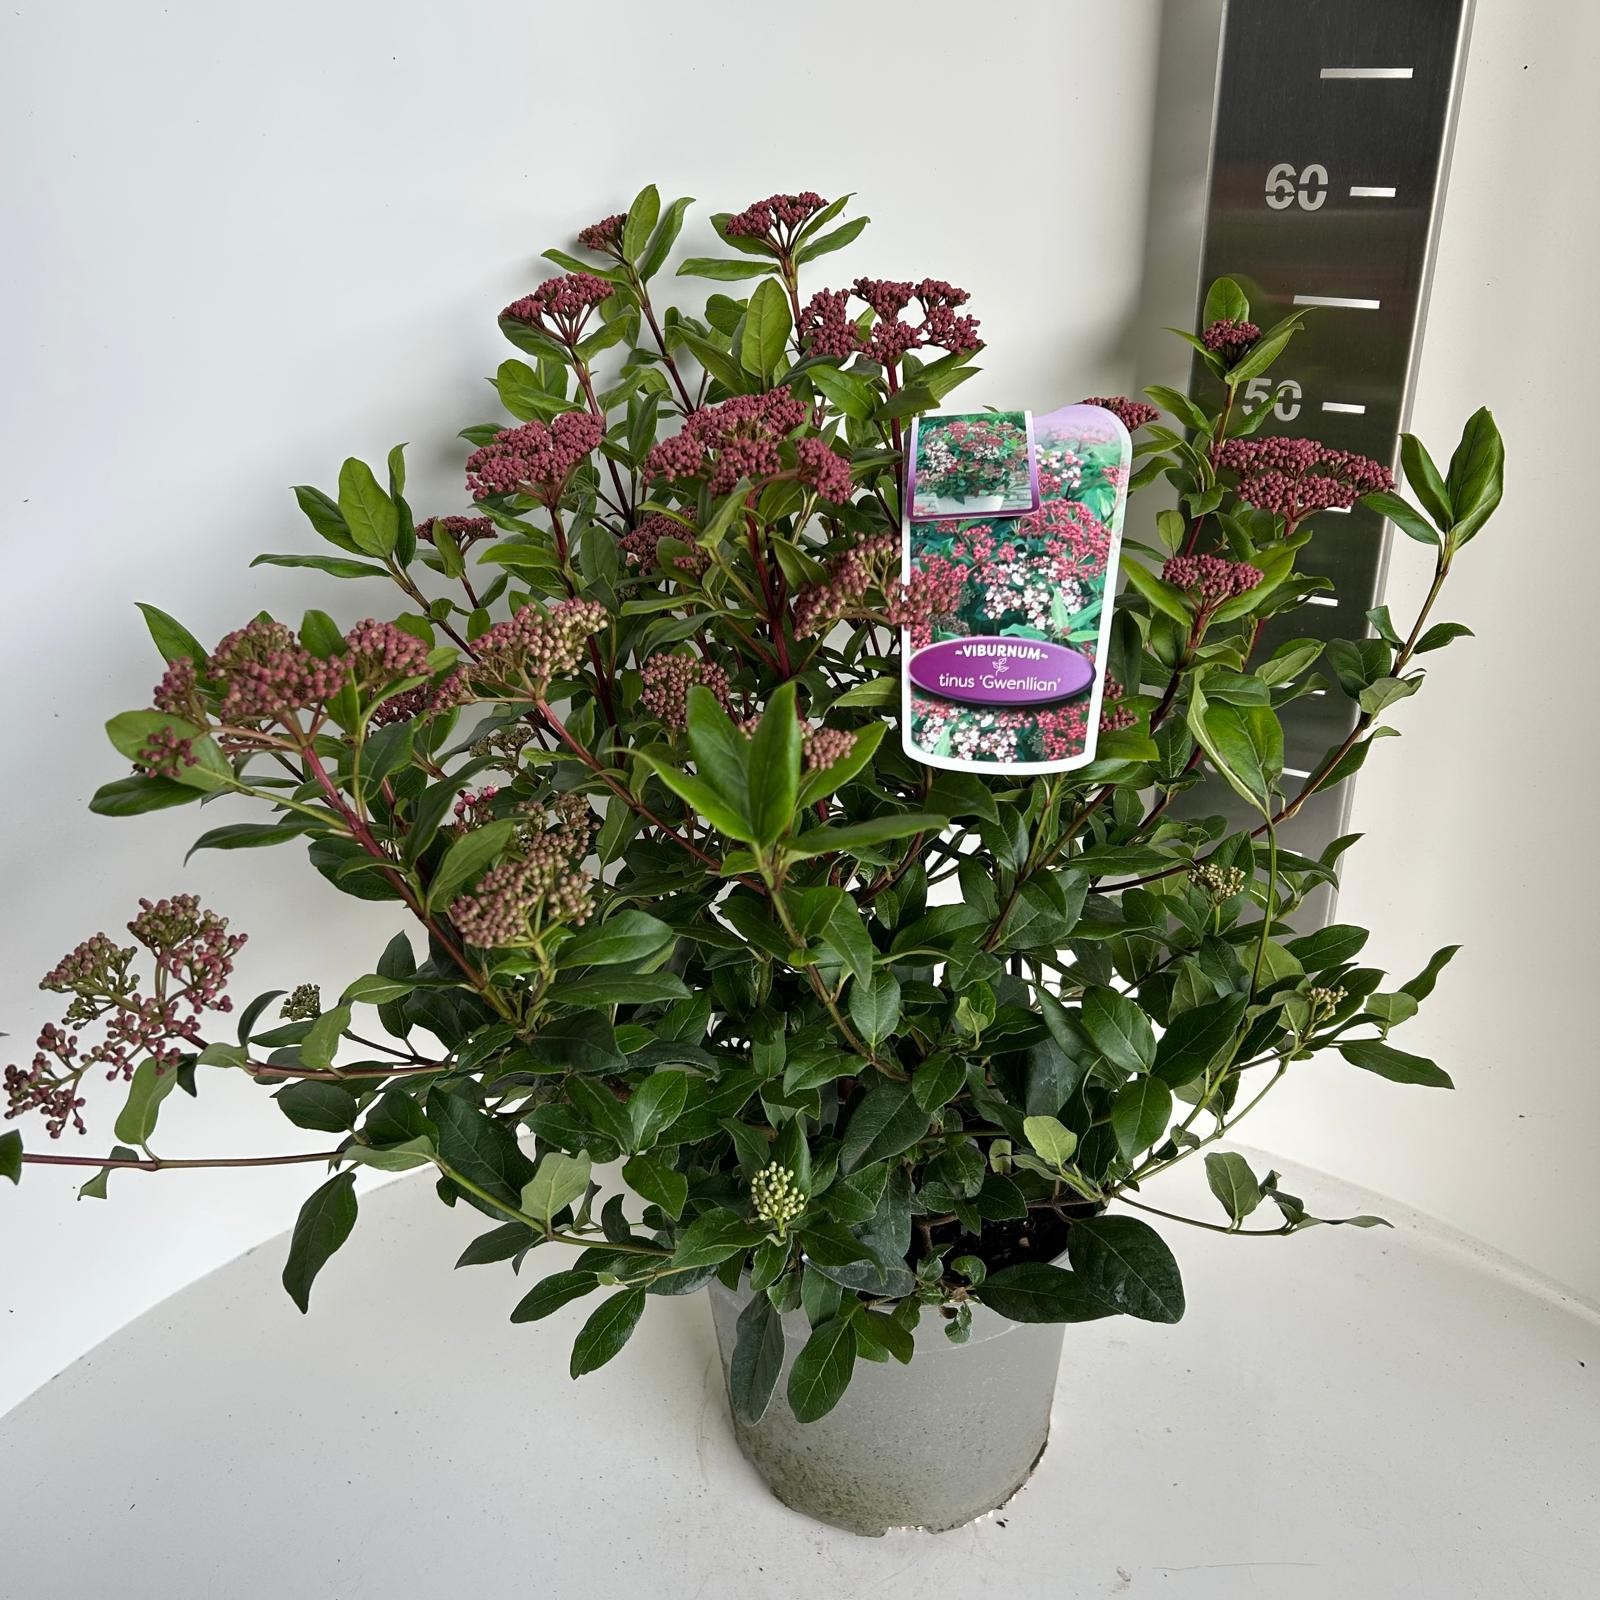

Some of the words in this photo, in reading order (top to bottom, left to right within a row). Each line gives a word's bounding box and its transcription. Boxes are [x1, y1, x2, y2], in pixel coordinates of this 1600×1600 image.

[1265, 163, 1329, 211] 60
[1241, 377, 1303, 421] 50
[939, 673, 975, 688] tinus
